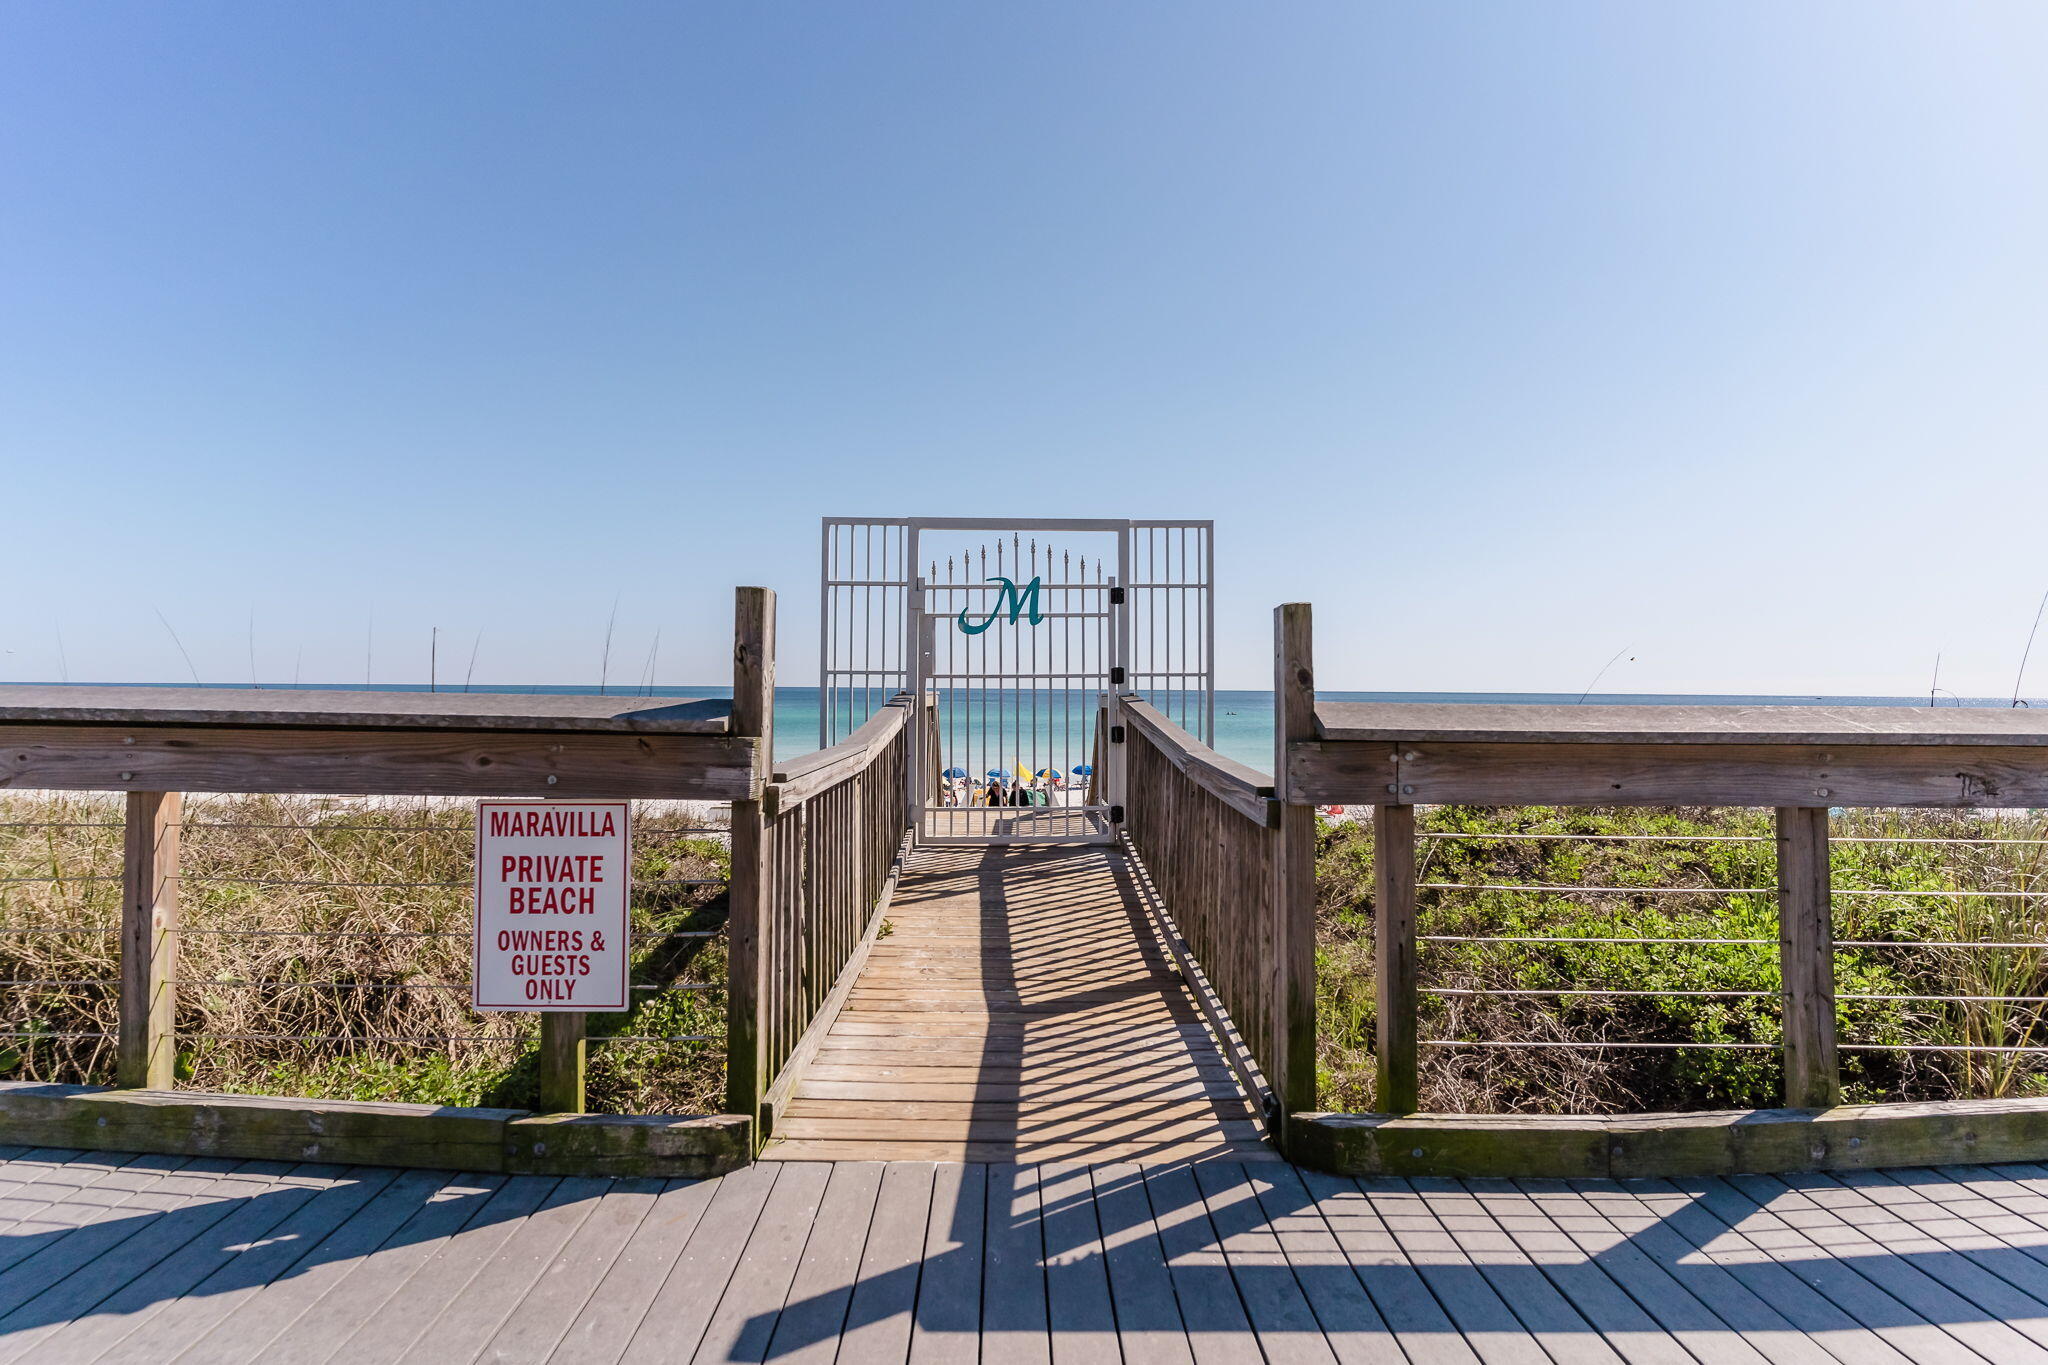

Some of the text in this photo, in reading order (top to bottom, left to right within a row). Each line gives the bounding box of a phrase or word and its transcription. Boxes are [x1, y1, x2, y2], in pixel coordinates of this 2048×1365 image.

[490, 811, 615, 837] MARAVILLA
[501, 855, 604, 883] PRIVATE
[509, 887, 595, 915] BEACH
[498, 930, 605, 952] OWNERS &
[511, 954, 590, 976] GUESTS
[525, 979, 576, 1000] ONLY
